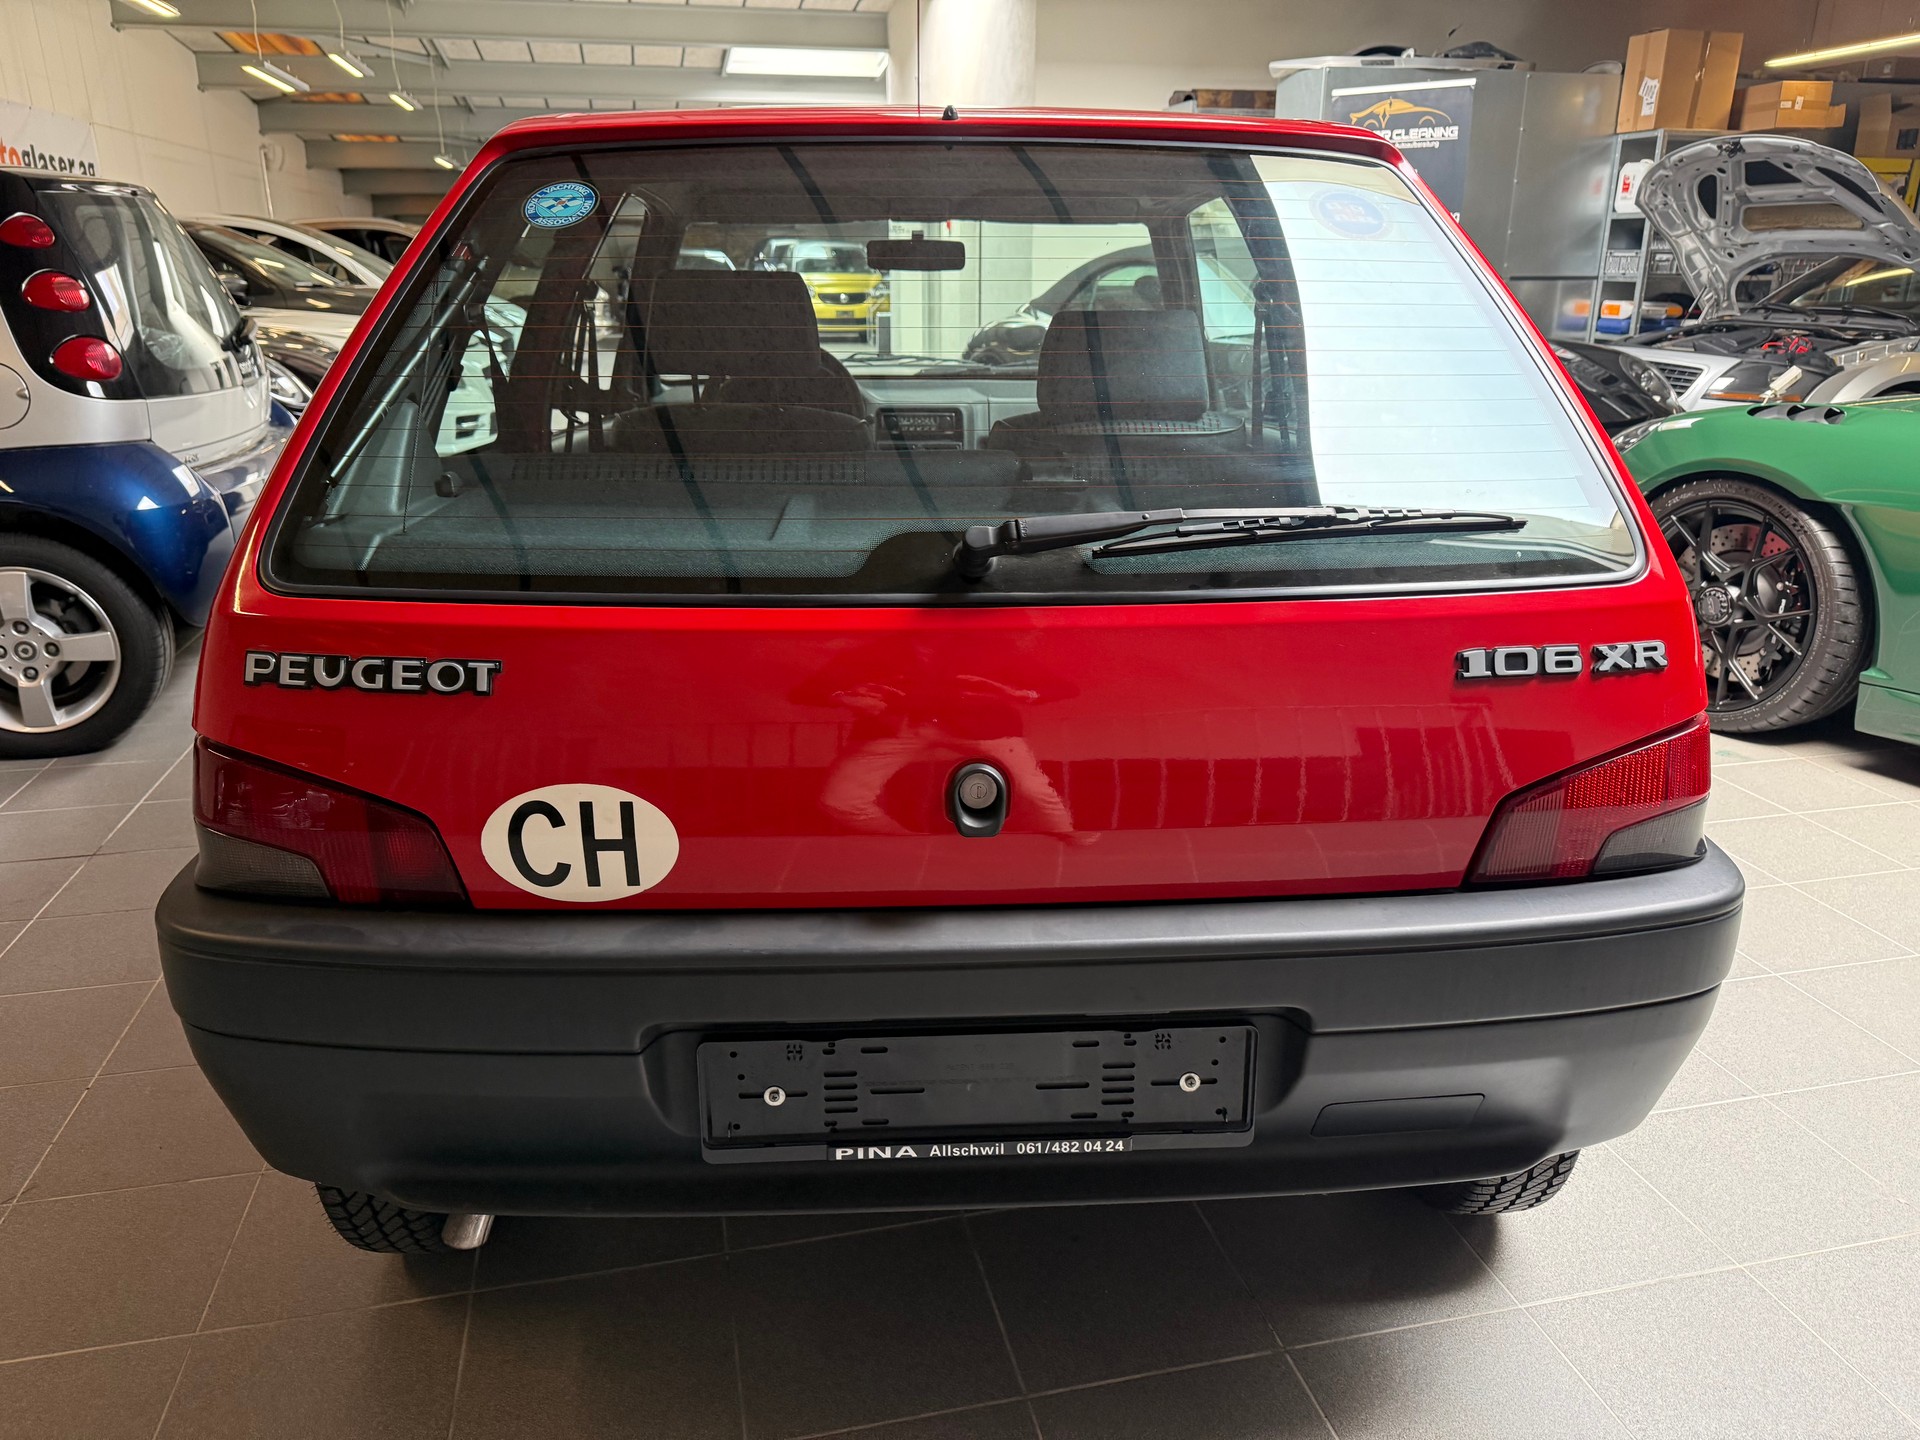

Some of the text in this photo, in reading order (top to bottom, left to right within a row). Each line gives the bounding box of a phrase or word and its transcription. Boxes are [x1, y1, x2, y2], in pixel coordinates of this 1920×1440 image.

[1391, 125, 1459, 141] CLEANING
[527, 184, 590, 214] ROYAL YACHTING
[533, 200, 592, 226] ASSOCIATION
[243, 651, 502, 696] PEUGEOT
[1456, 640, 1668, 680] 106 XR
[507, 799, 641, 888] CH
[835, 1139, 1125, 1161] PINA Allschwil 061/482 04 24
